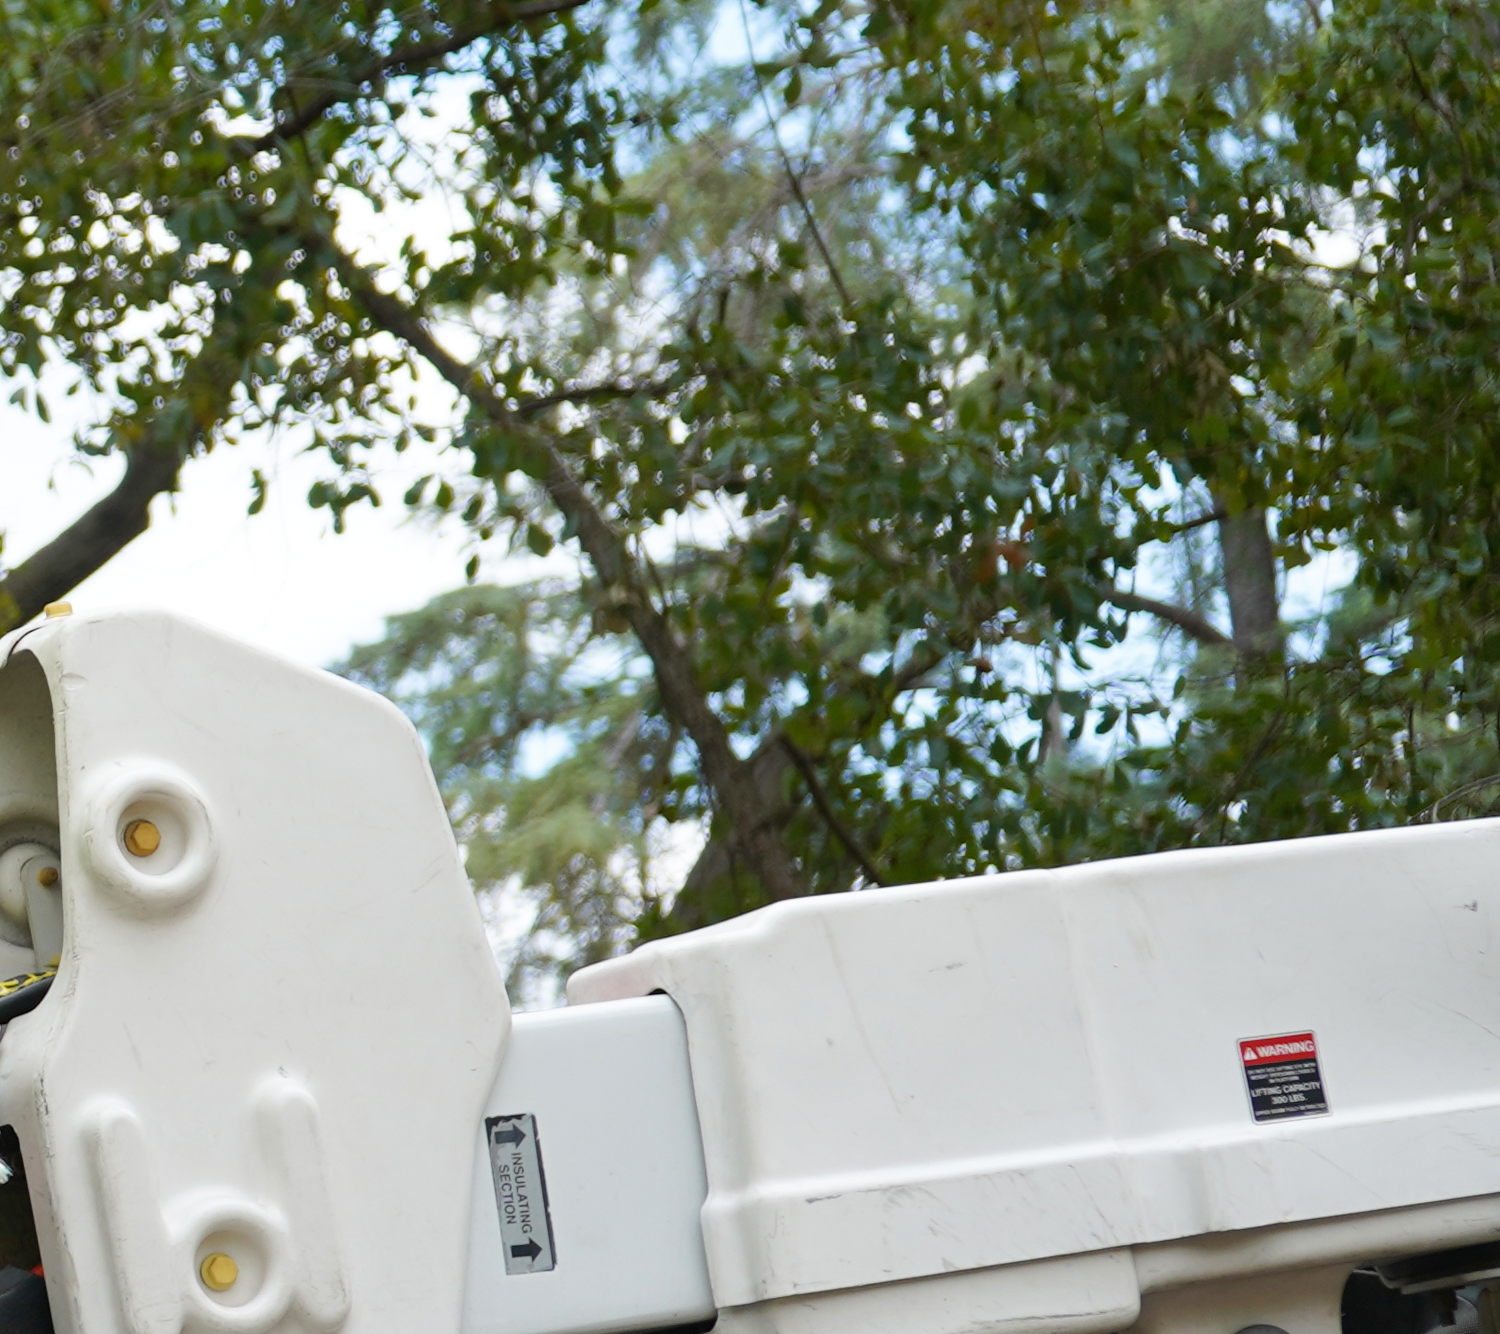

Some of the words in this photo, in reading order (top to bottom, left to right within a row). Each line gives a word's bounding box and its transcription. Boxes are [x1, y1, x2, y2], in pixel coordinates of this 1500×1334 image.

[1256, 1040, 1315, 1058] WARNING
[1250, 1086, 1282, 1098] LIFTING
[1282, 1081, 1321, 1094] CAPACITY
[498, 1164, 517, 1225] SECTION
[511, 1152, 533, 1234] INSULATING
